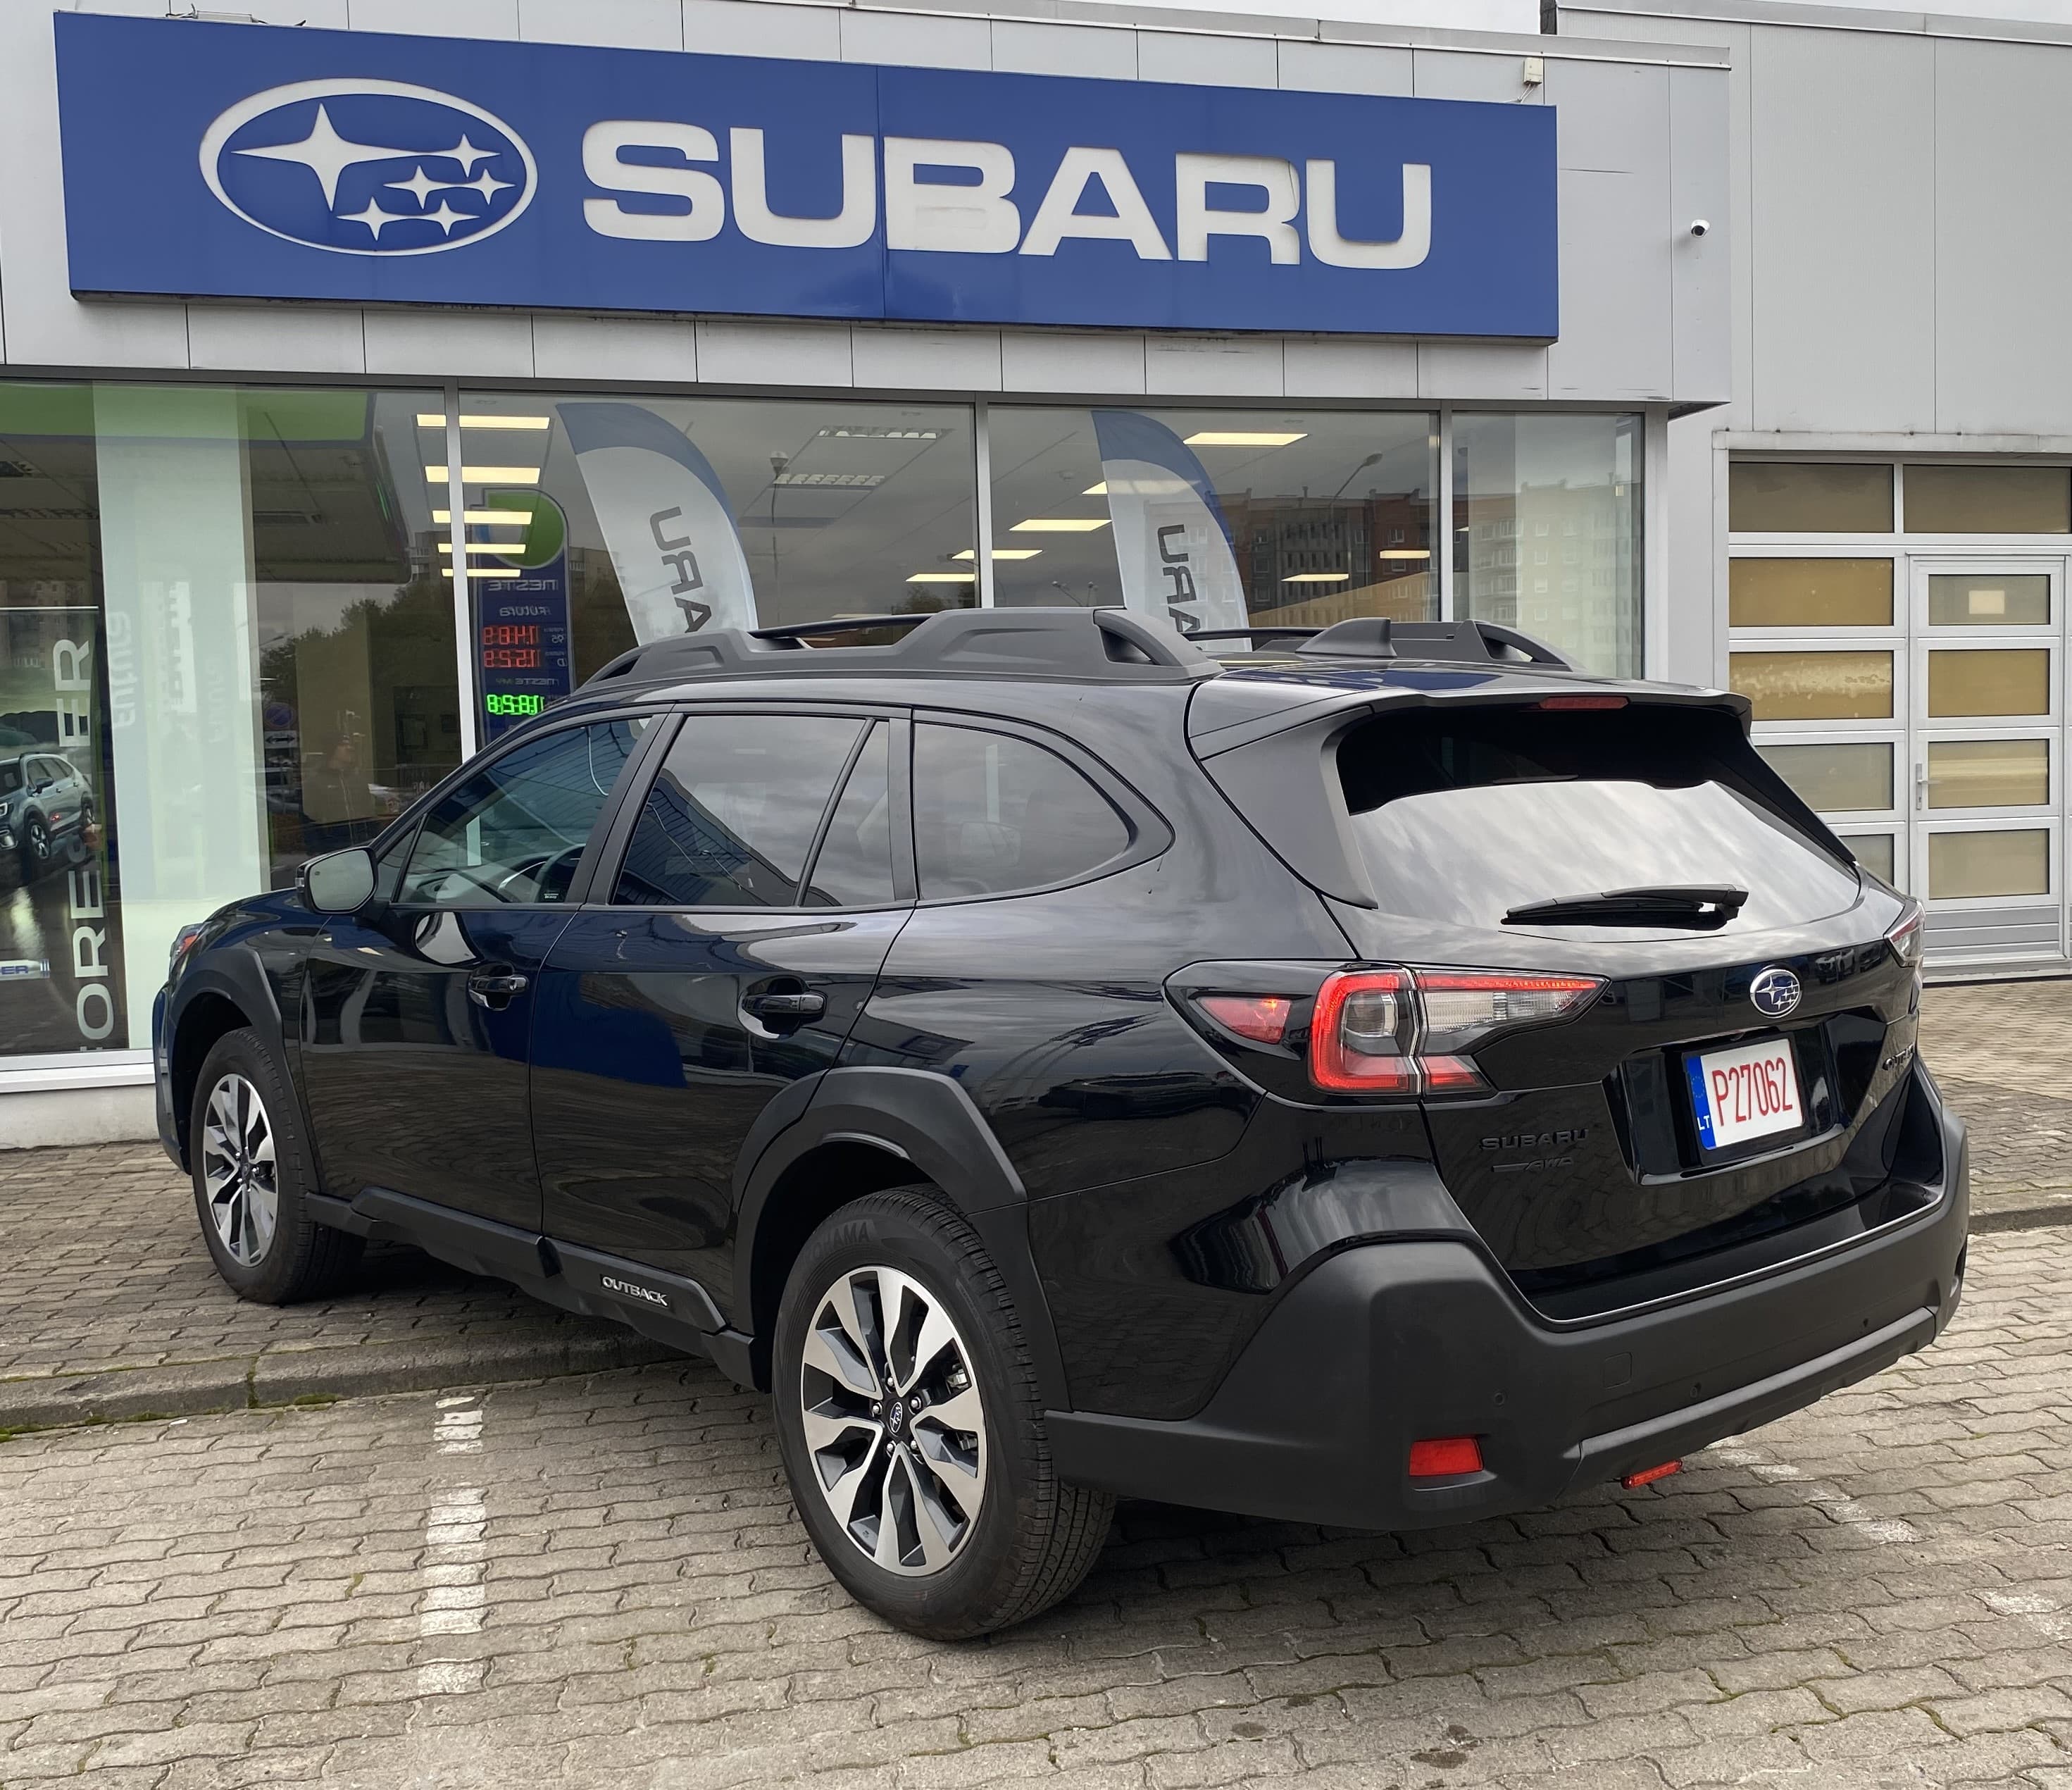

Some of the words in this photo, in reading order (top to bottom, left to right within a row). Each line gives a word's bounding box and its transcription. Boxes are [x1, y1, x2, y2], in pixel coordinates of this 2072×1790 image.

[582, 120, 1432, 270] SUBARU
[1711, 1057, 1792, 1126] P27062
[1697, 1114, 1710, 1131] LT
[1479, 1128, 1589, 1152] SUBARU
[601, 1275, 668, 1307] OUTBACK
